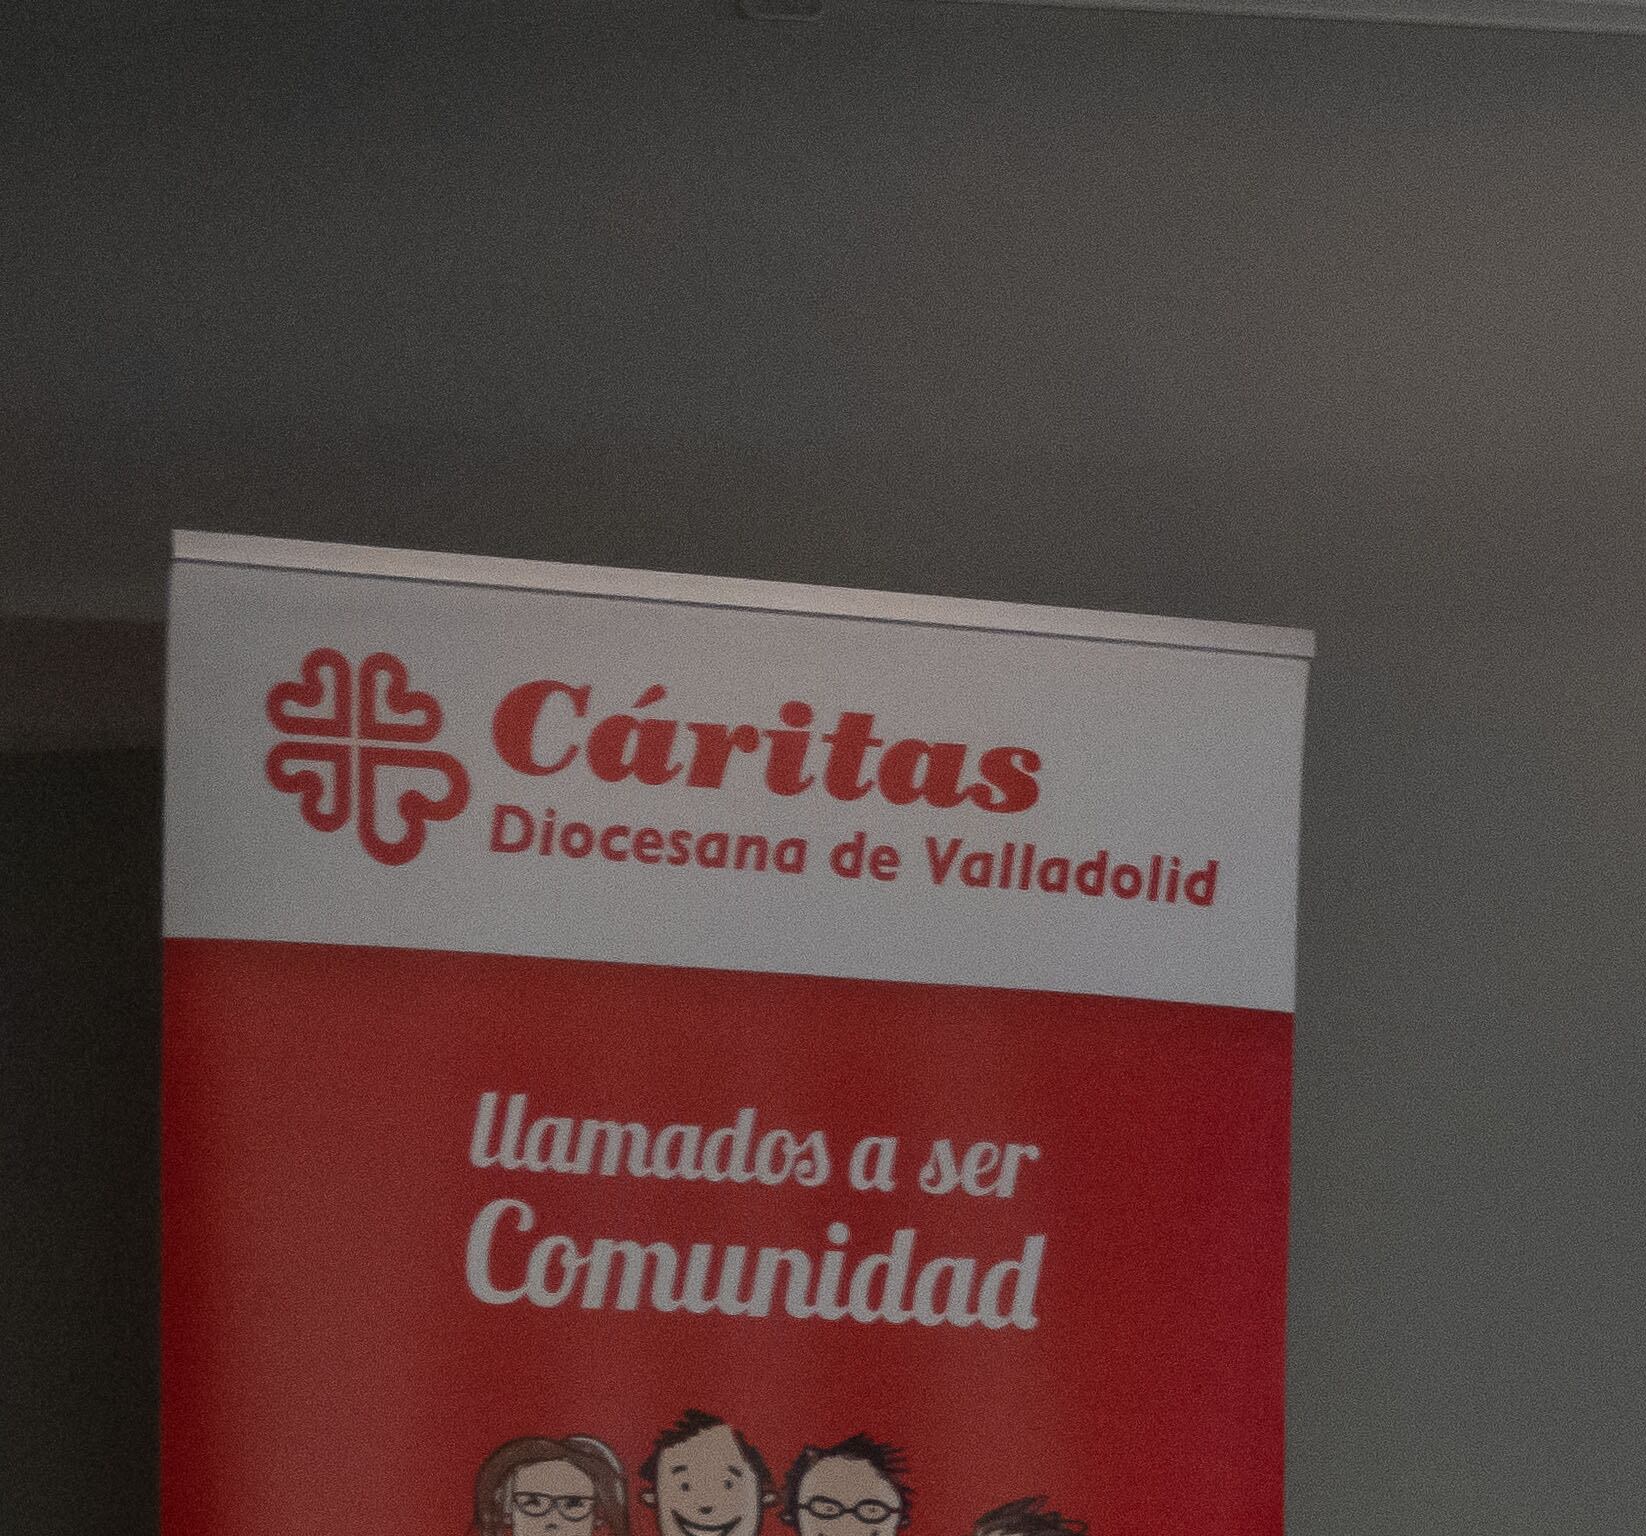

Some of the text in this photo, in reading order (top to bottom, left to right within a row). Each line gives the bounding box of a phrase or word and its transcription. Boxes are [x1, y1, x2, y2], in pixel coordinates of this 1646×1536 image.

[492, 676, 1042, 814] Cáritas
[488, 805, 1221, 907] Diocesana de Valladolid
[469, 1090, 1039, 1199] llamados a ser
[466, 1198, 1047, 1332] Comunidad
